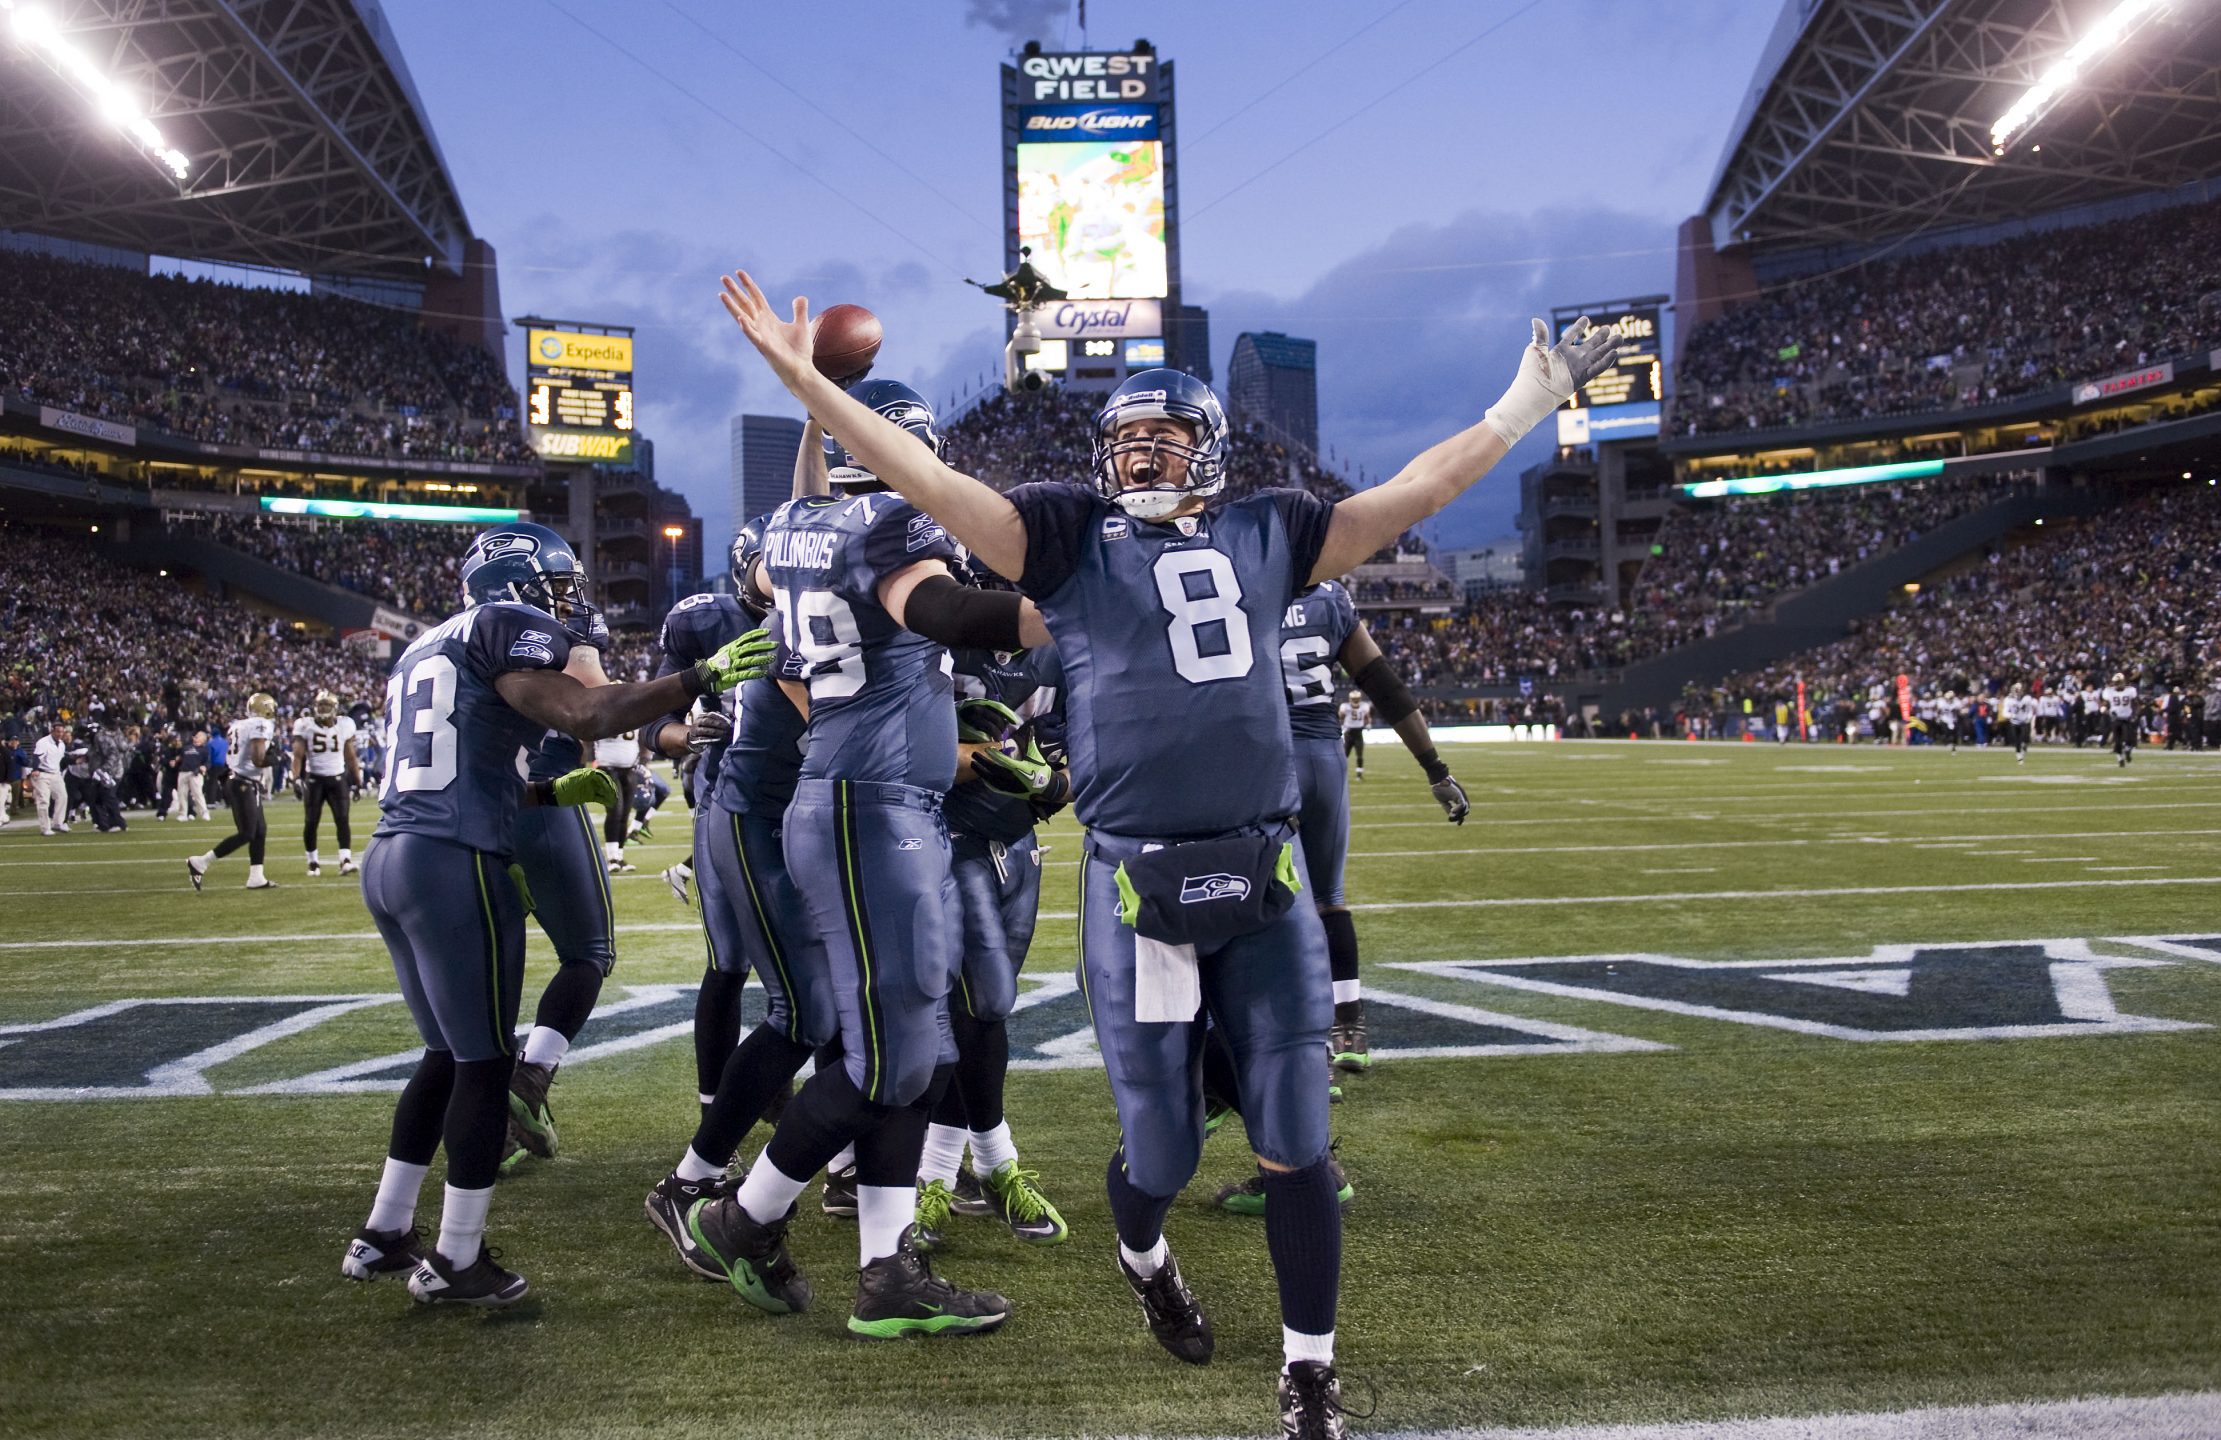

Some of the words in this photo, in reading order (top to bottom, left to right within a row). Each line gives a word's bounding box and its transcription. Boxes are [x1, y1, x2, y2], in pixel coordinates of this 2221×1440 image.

[1023, 55, 1154, 80] QWEST
[1034, 79, 1147, 100] FIELD
[1055, 302, 1132, 335] Crystal
[566, 343, 624, 362] Expedia
[2103, 370, 2164, 394] FARMERS
[536, 433, 630, 458] SUBWAY
[1153, 548, 1254, 684] 8
[312, 733, 339, 753] 51
